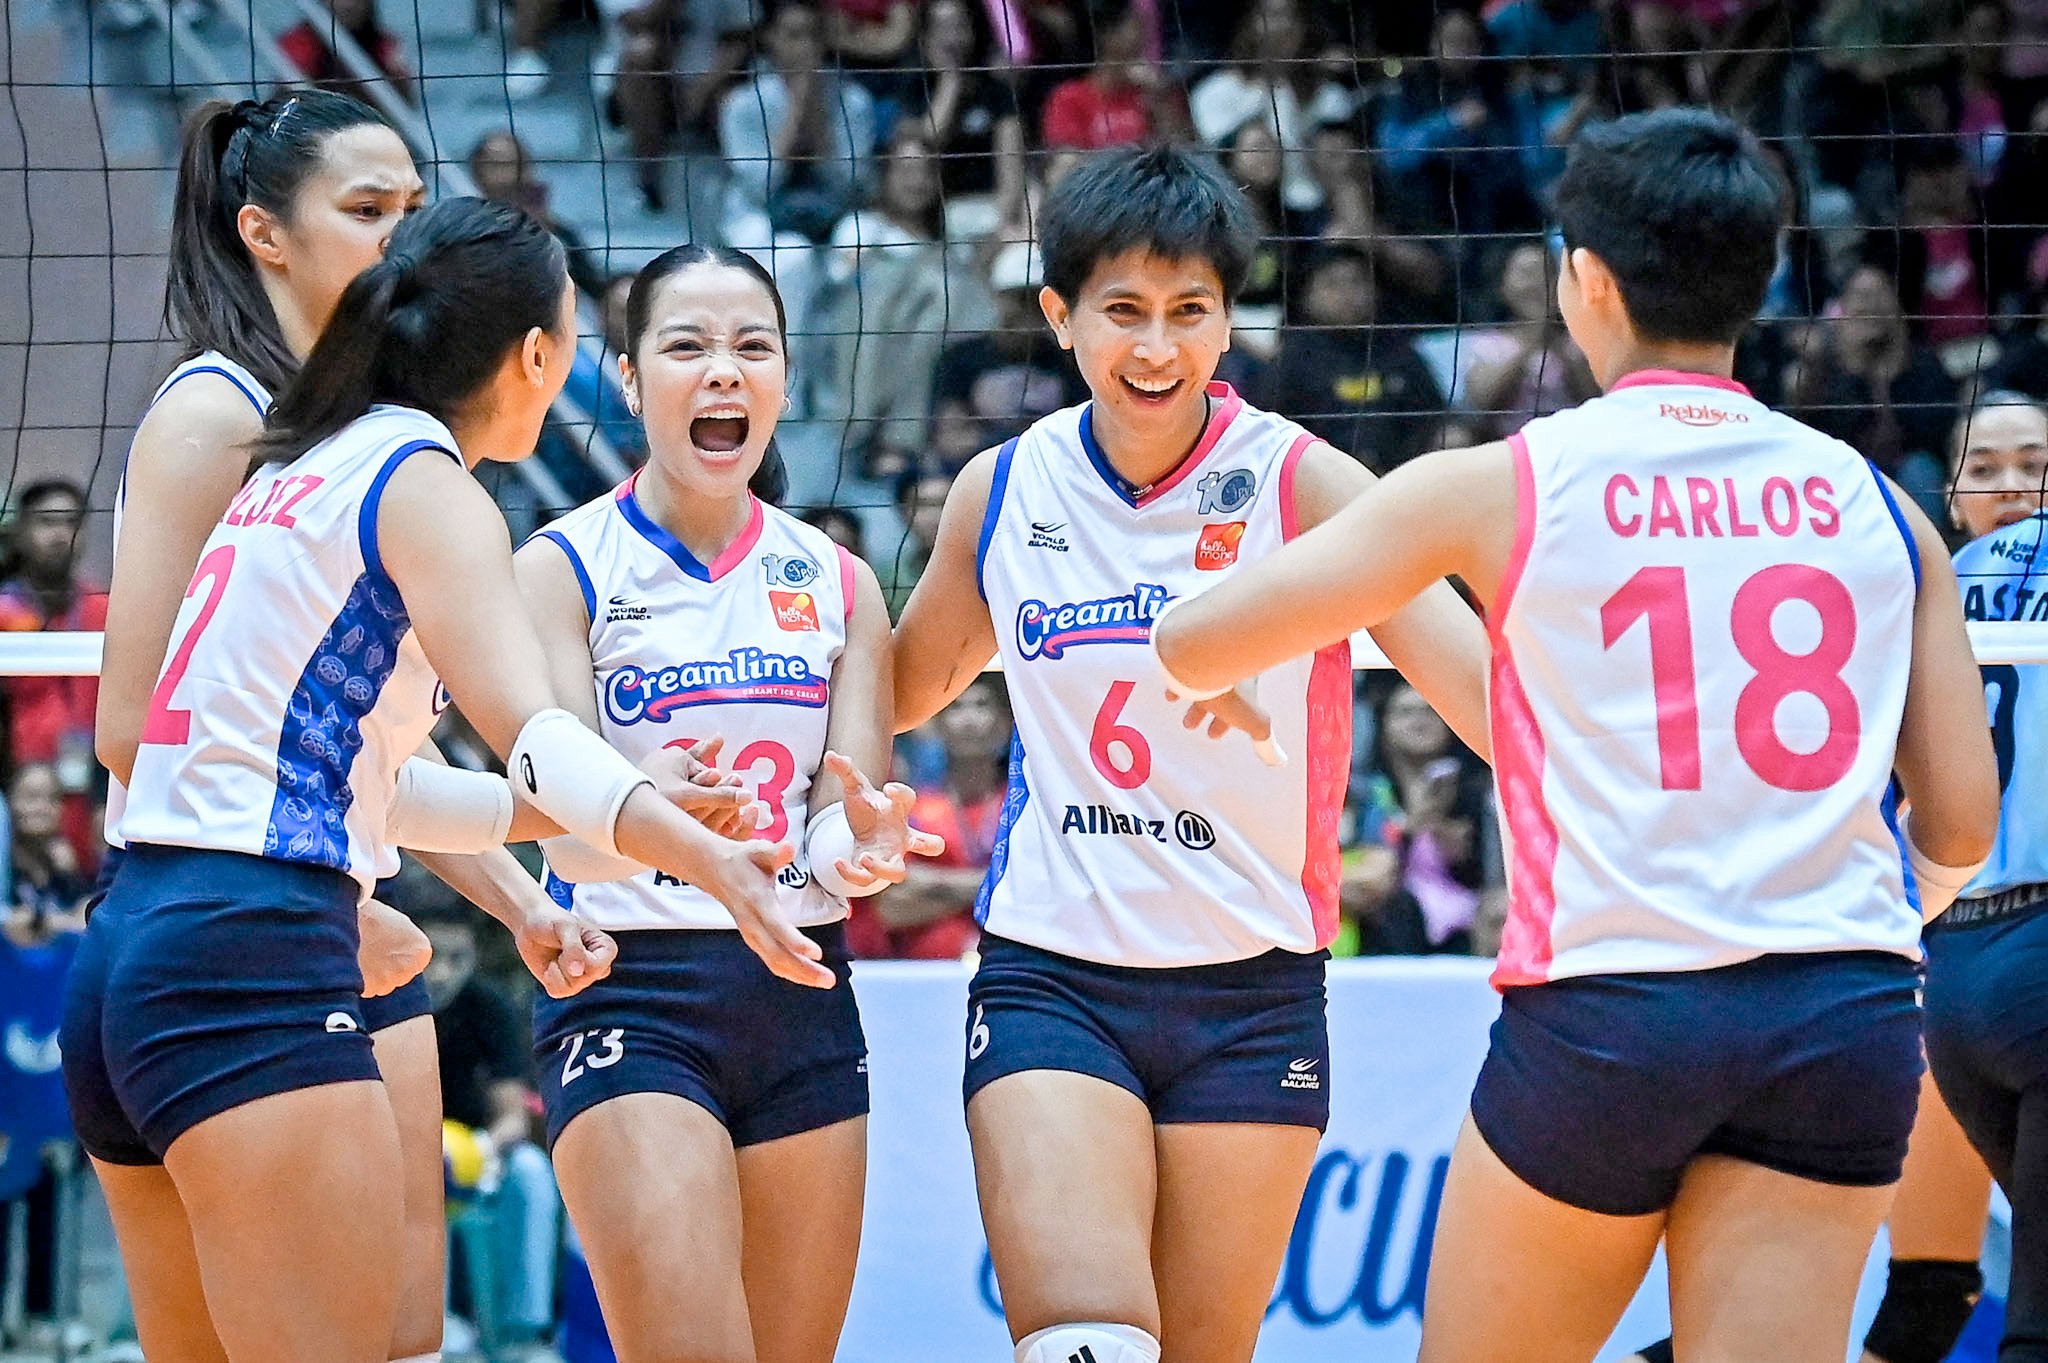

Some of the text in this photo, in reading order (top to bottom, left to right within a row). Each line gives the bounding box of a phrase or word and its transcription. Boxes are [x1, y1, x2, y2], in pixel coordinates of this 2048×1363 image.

[1658, 403, 1749, 427] Rebisco
[1604, 473, 1841, 538] CARLOS
[1200, 540, 1227, 553] hello
[141, 544, 236, 745] 2
[1017, 585, 1170, 658] Creamli
[606, 649, 810, 719] Creamline
[780, 688, 795, 696] ICE
[1600, 563, 1861, 793] 18
[1089, 680, 1152, 790] 6
[1062, 804, 1168, 843] Allianz
[558, 1028, 625, 1089] 23
[969, 1003, 991, 1060] 6
[1287, 1072, 1318, 1082] WORLD
